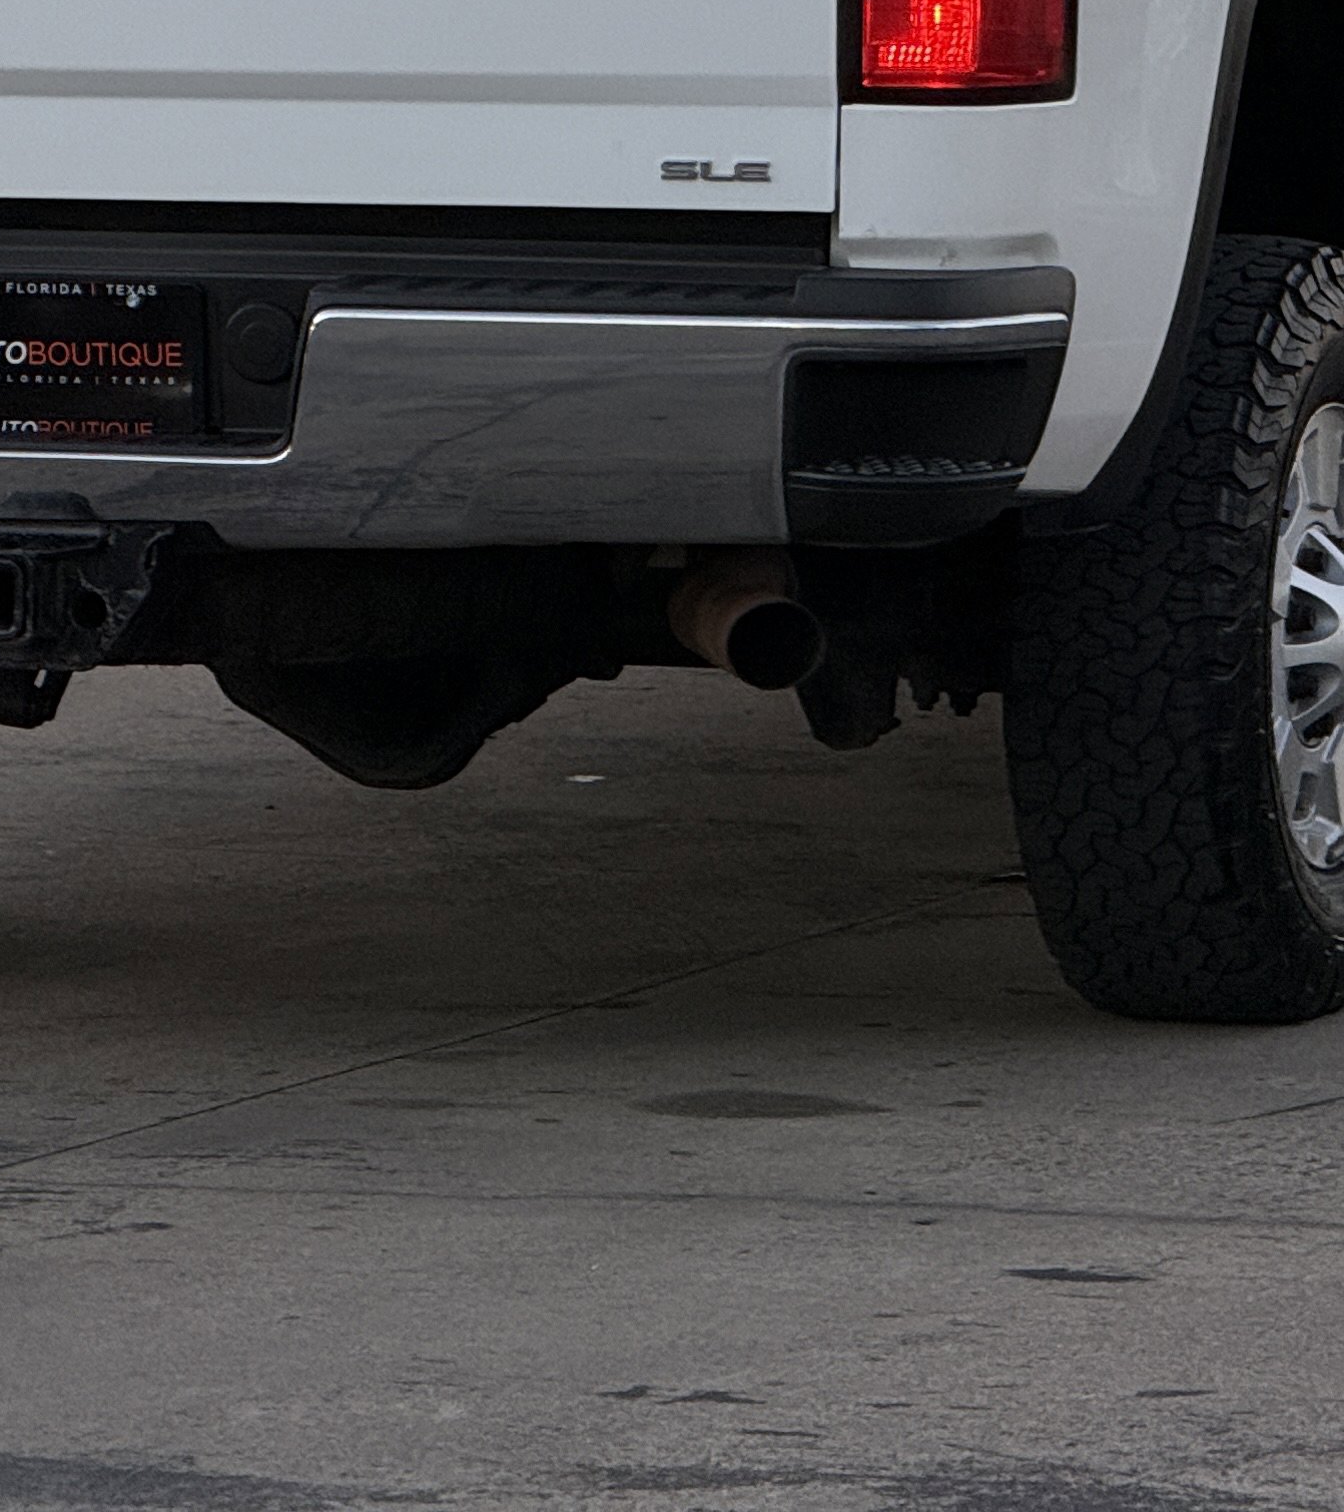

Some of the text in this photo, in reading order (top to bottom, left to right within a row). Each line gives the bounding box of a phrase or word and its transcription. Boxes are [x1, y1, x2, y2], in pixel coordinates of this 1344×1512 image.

[660, 158, 772, 183] SLE
[5, 282, 82, 295] FLORIDA
[105, 284, 157, 296] TEXAS
[111, 375, 175, 386] TEXAS
